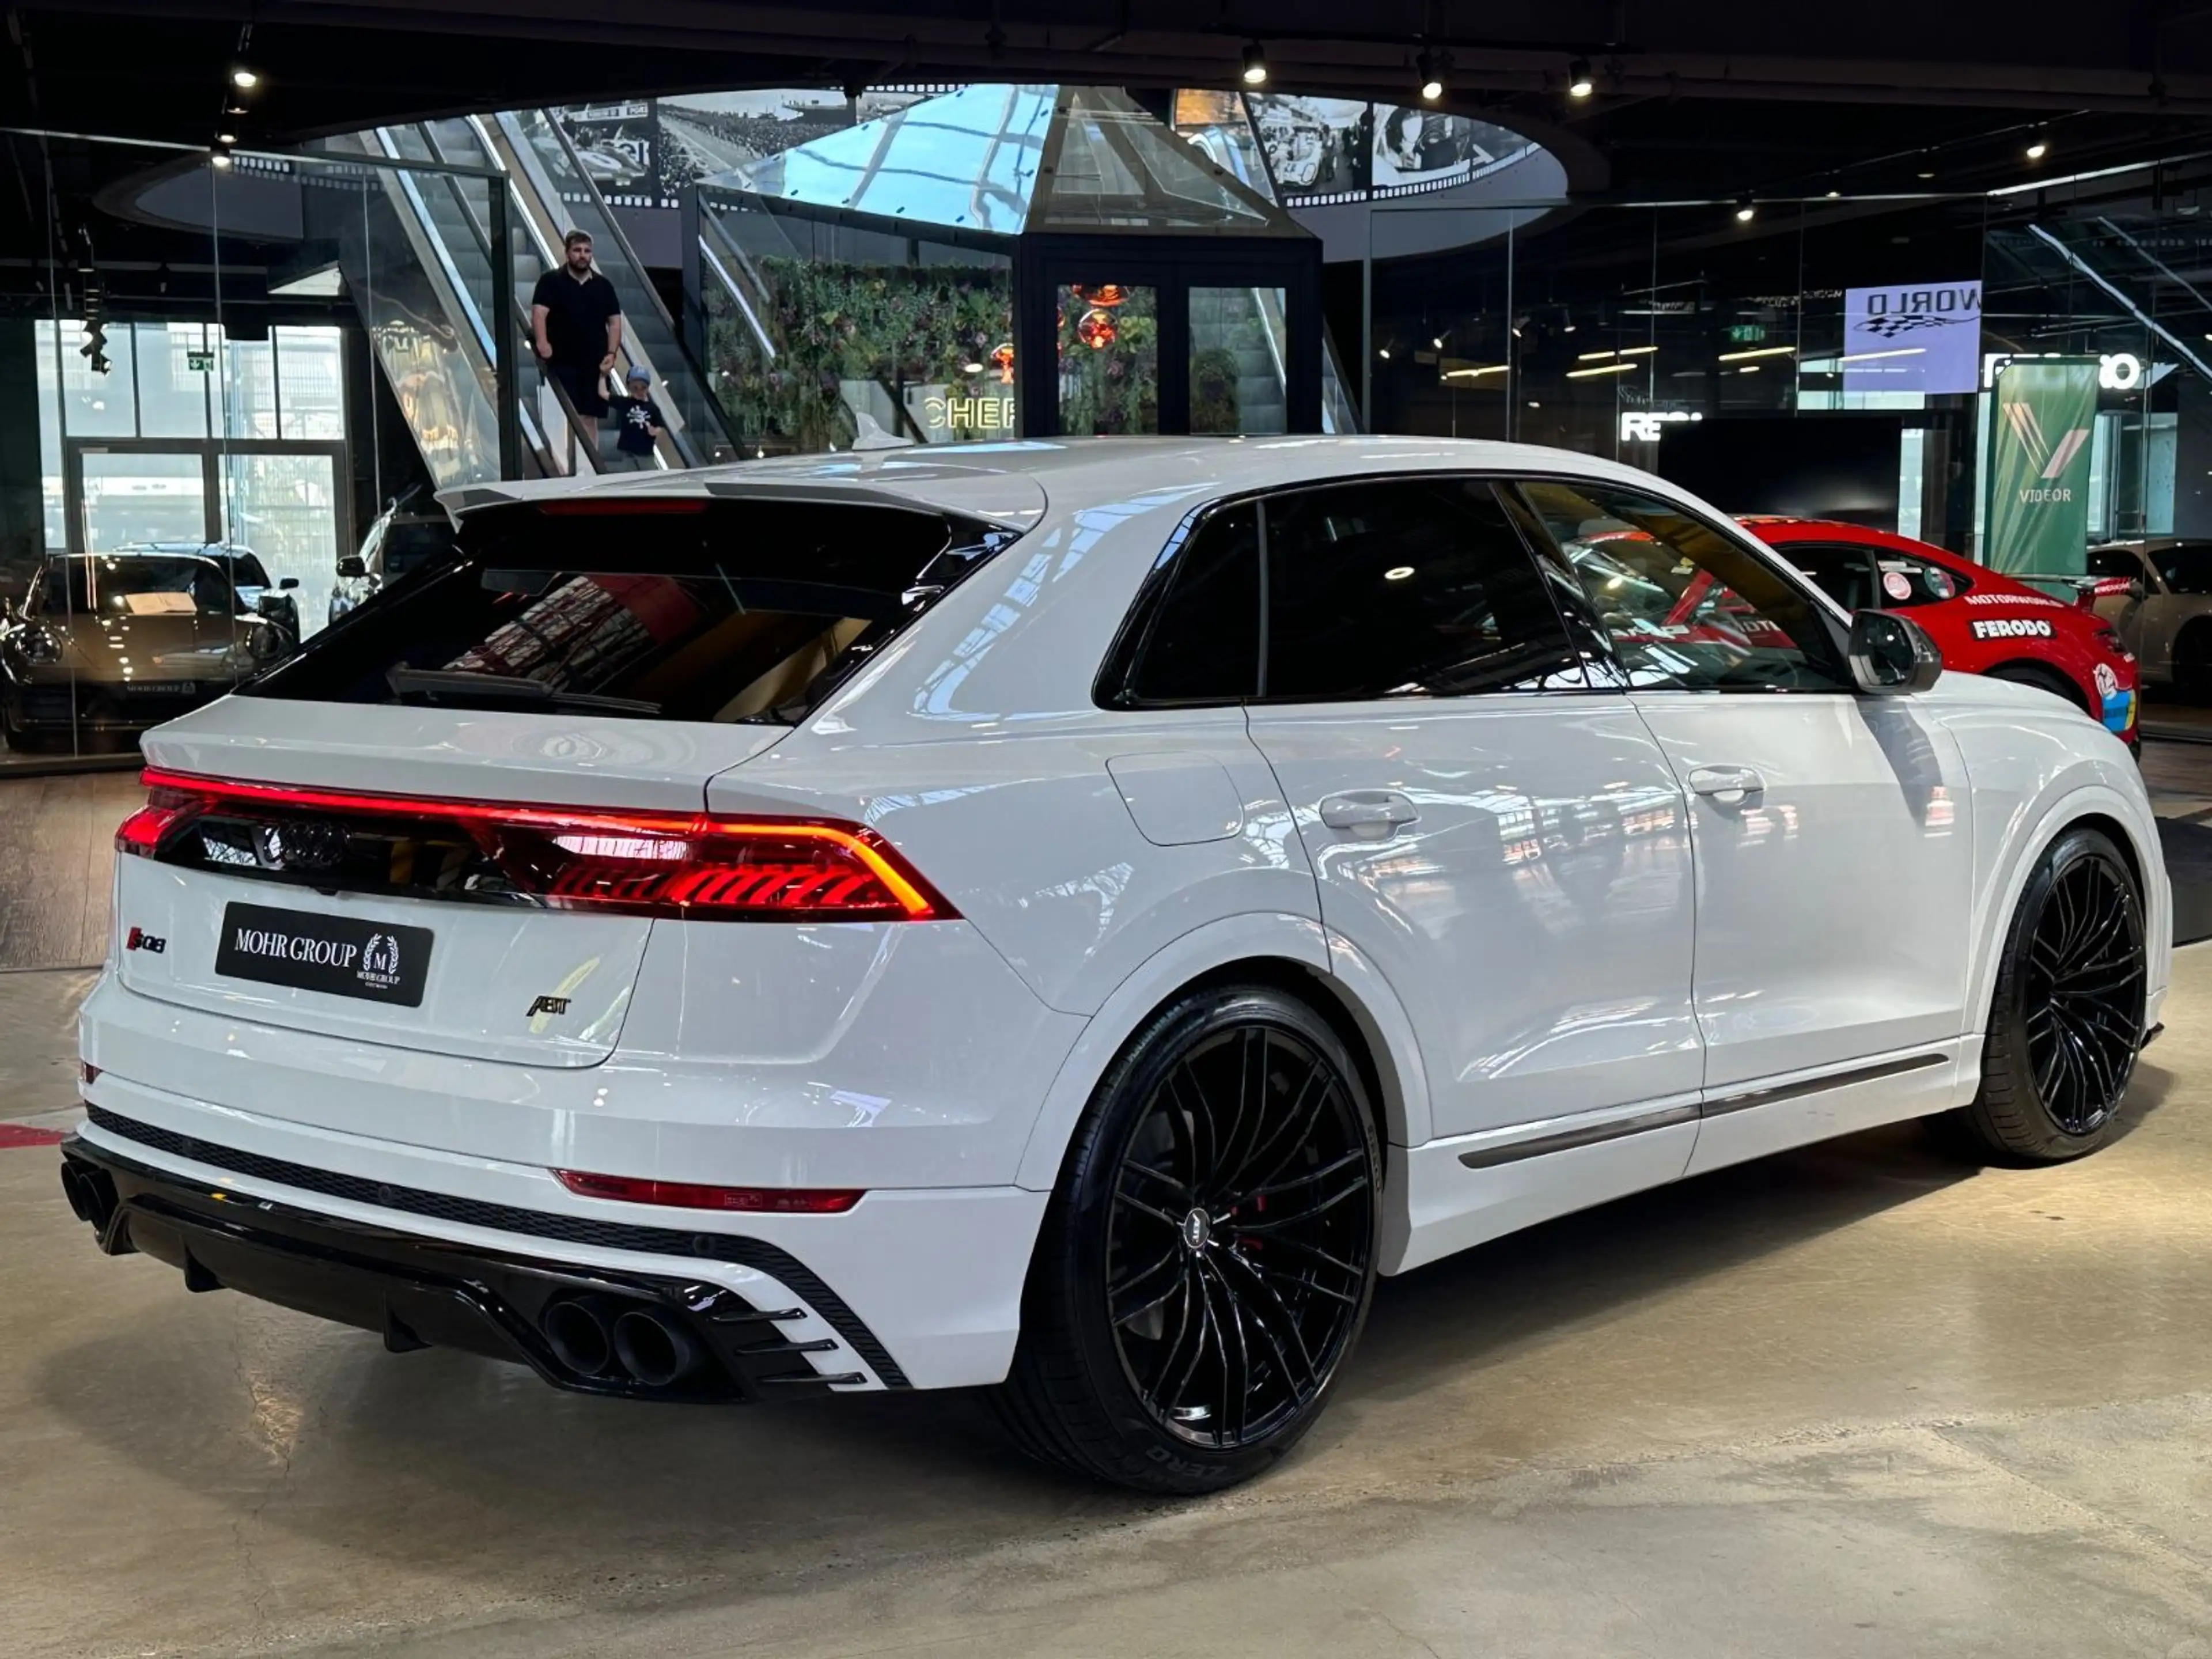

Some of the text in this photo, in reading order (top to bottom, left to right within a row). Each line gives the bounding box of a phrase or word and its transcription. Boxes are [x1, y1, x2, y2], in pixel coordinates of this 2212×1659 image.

[2019, 488, 2071, 503] VIDEOR
[1972, 619, 2051, 638] FERODO
[234, 928, 357, 968] MOHR GROUP
[373, 952, 387, 970] M
[526, 995, 571, 1017] ABT
